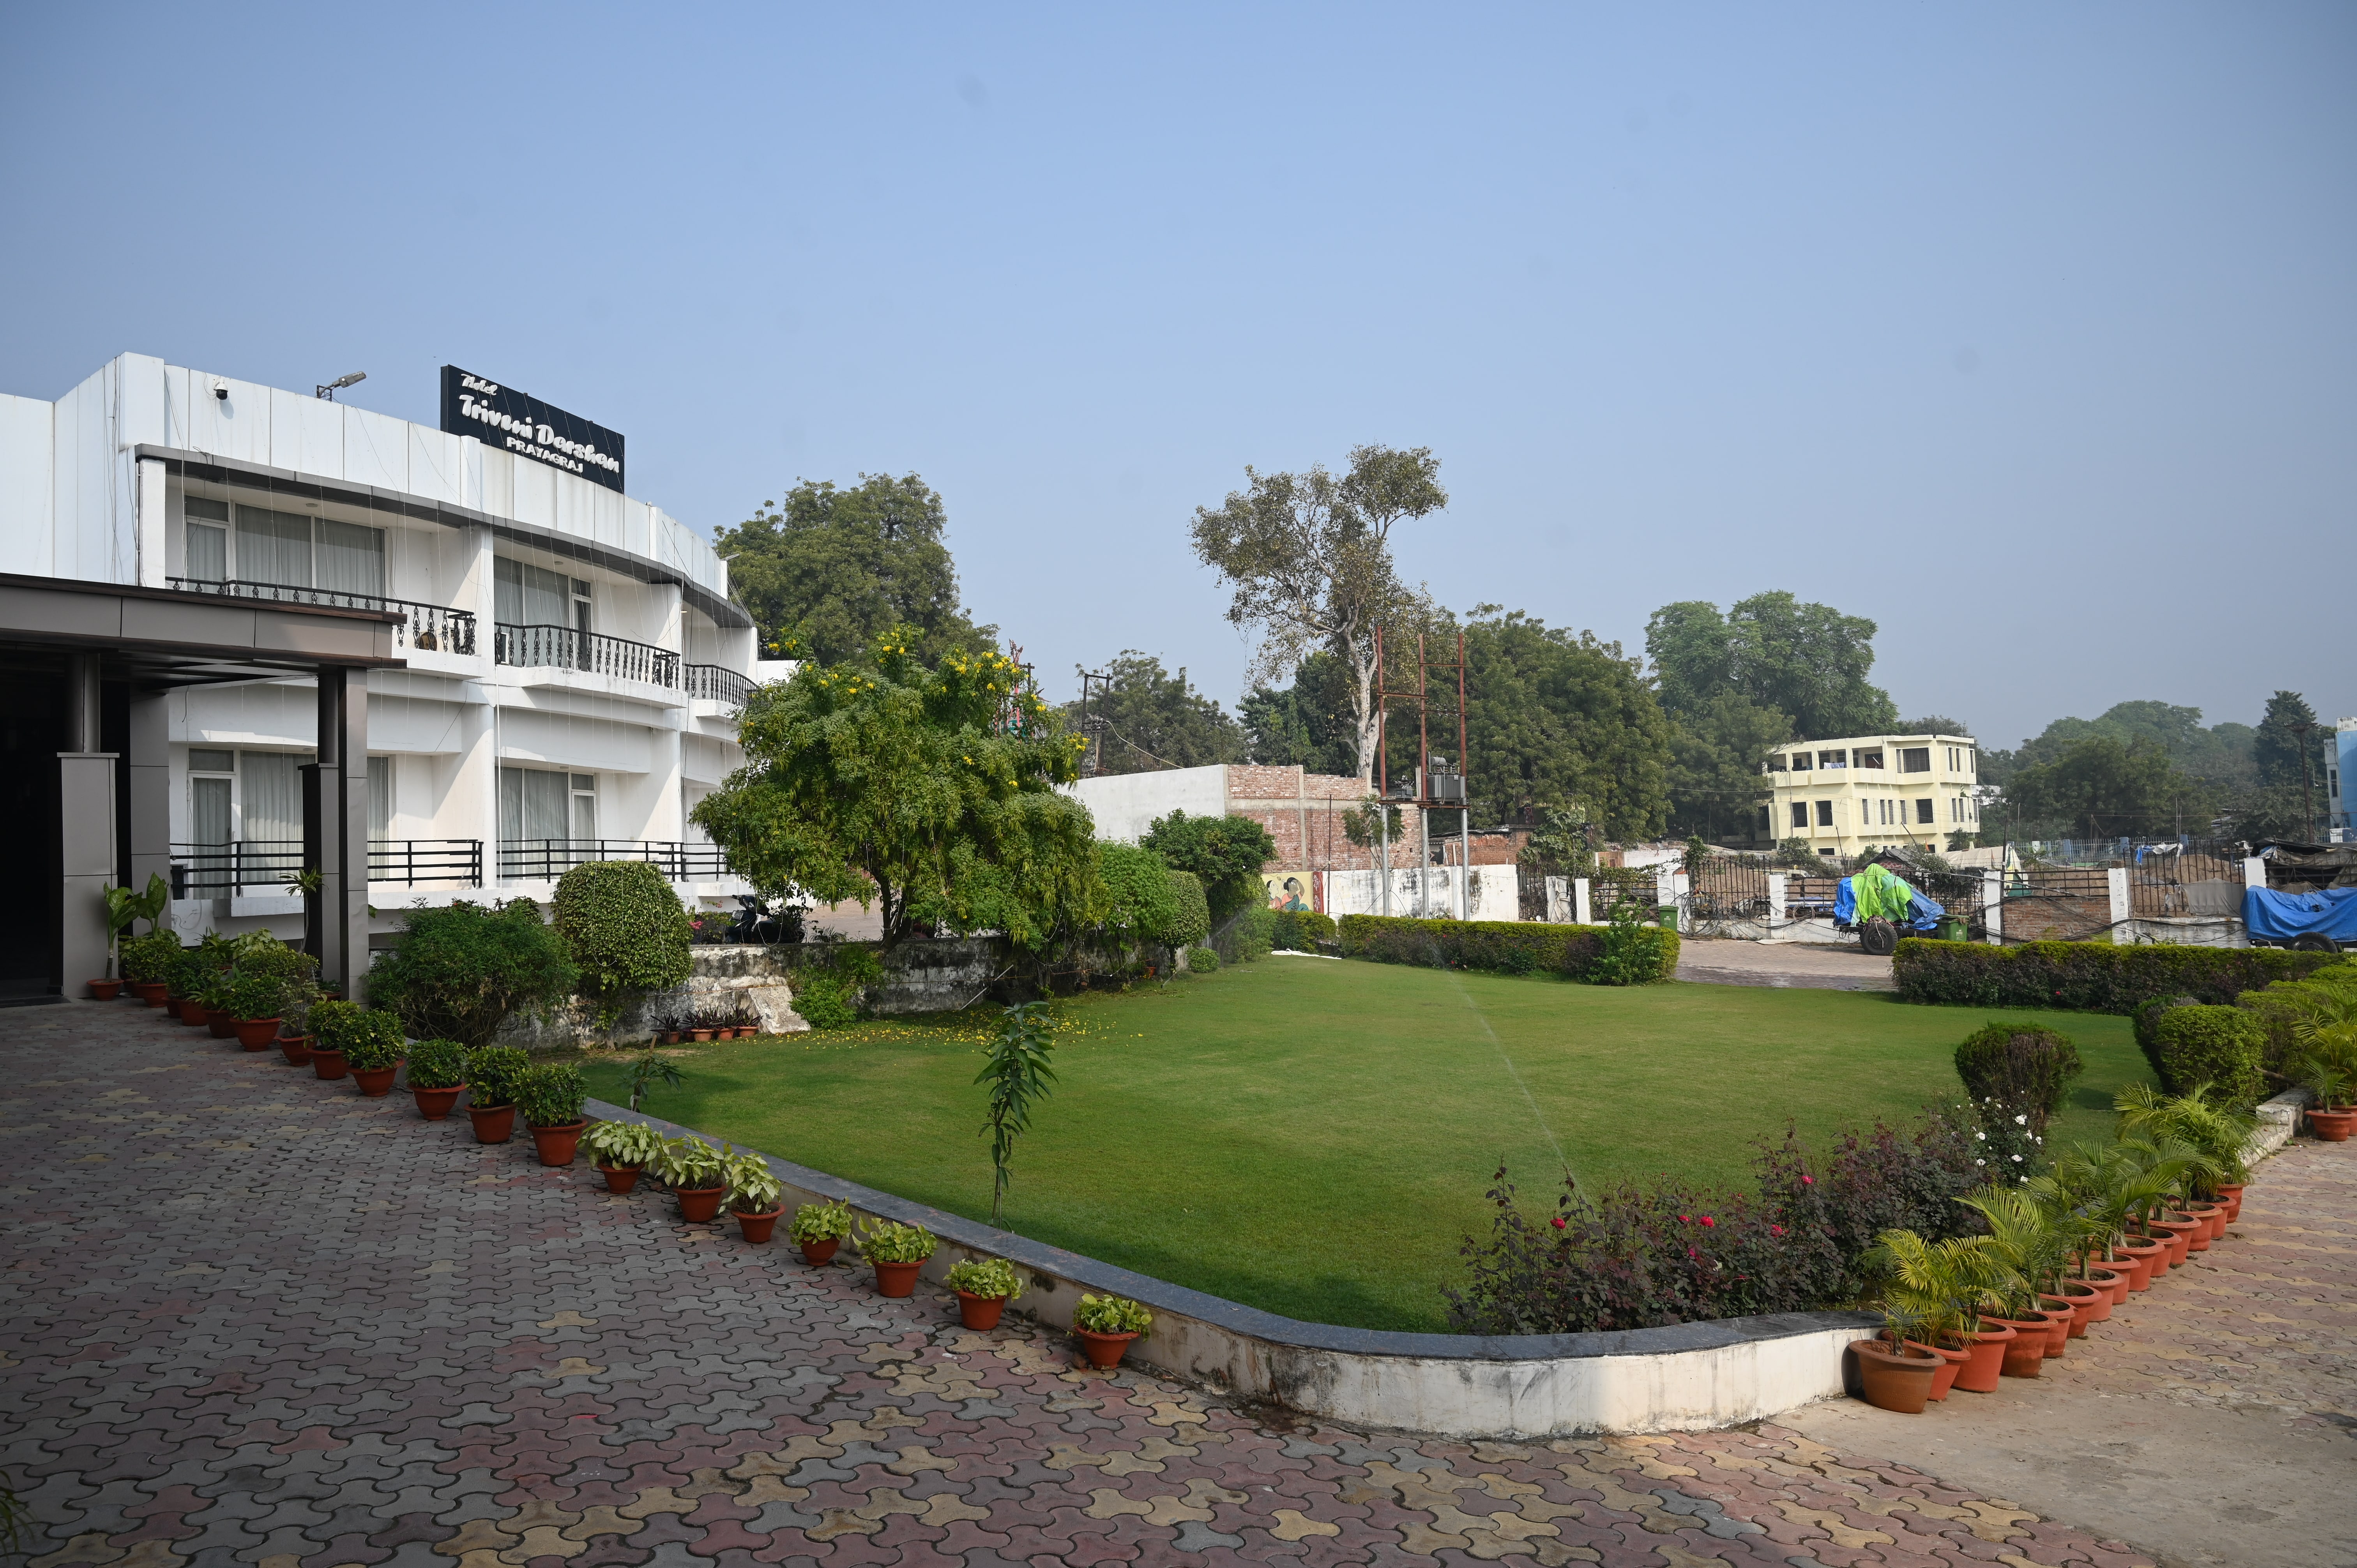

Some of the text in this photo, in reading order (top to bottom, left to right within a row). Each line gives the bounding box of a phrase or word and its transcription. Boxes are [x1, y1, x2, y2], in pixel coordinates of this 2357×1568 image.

[461, 374, 498, 396] Hotel
[459, 394, 619, 473] Triveni Darshan
[507, 437, 583, 473] PRAYAGRAJ
